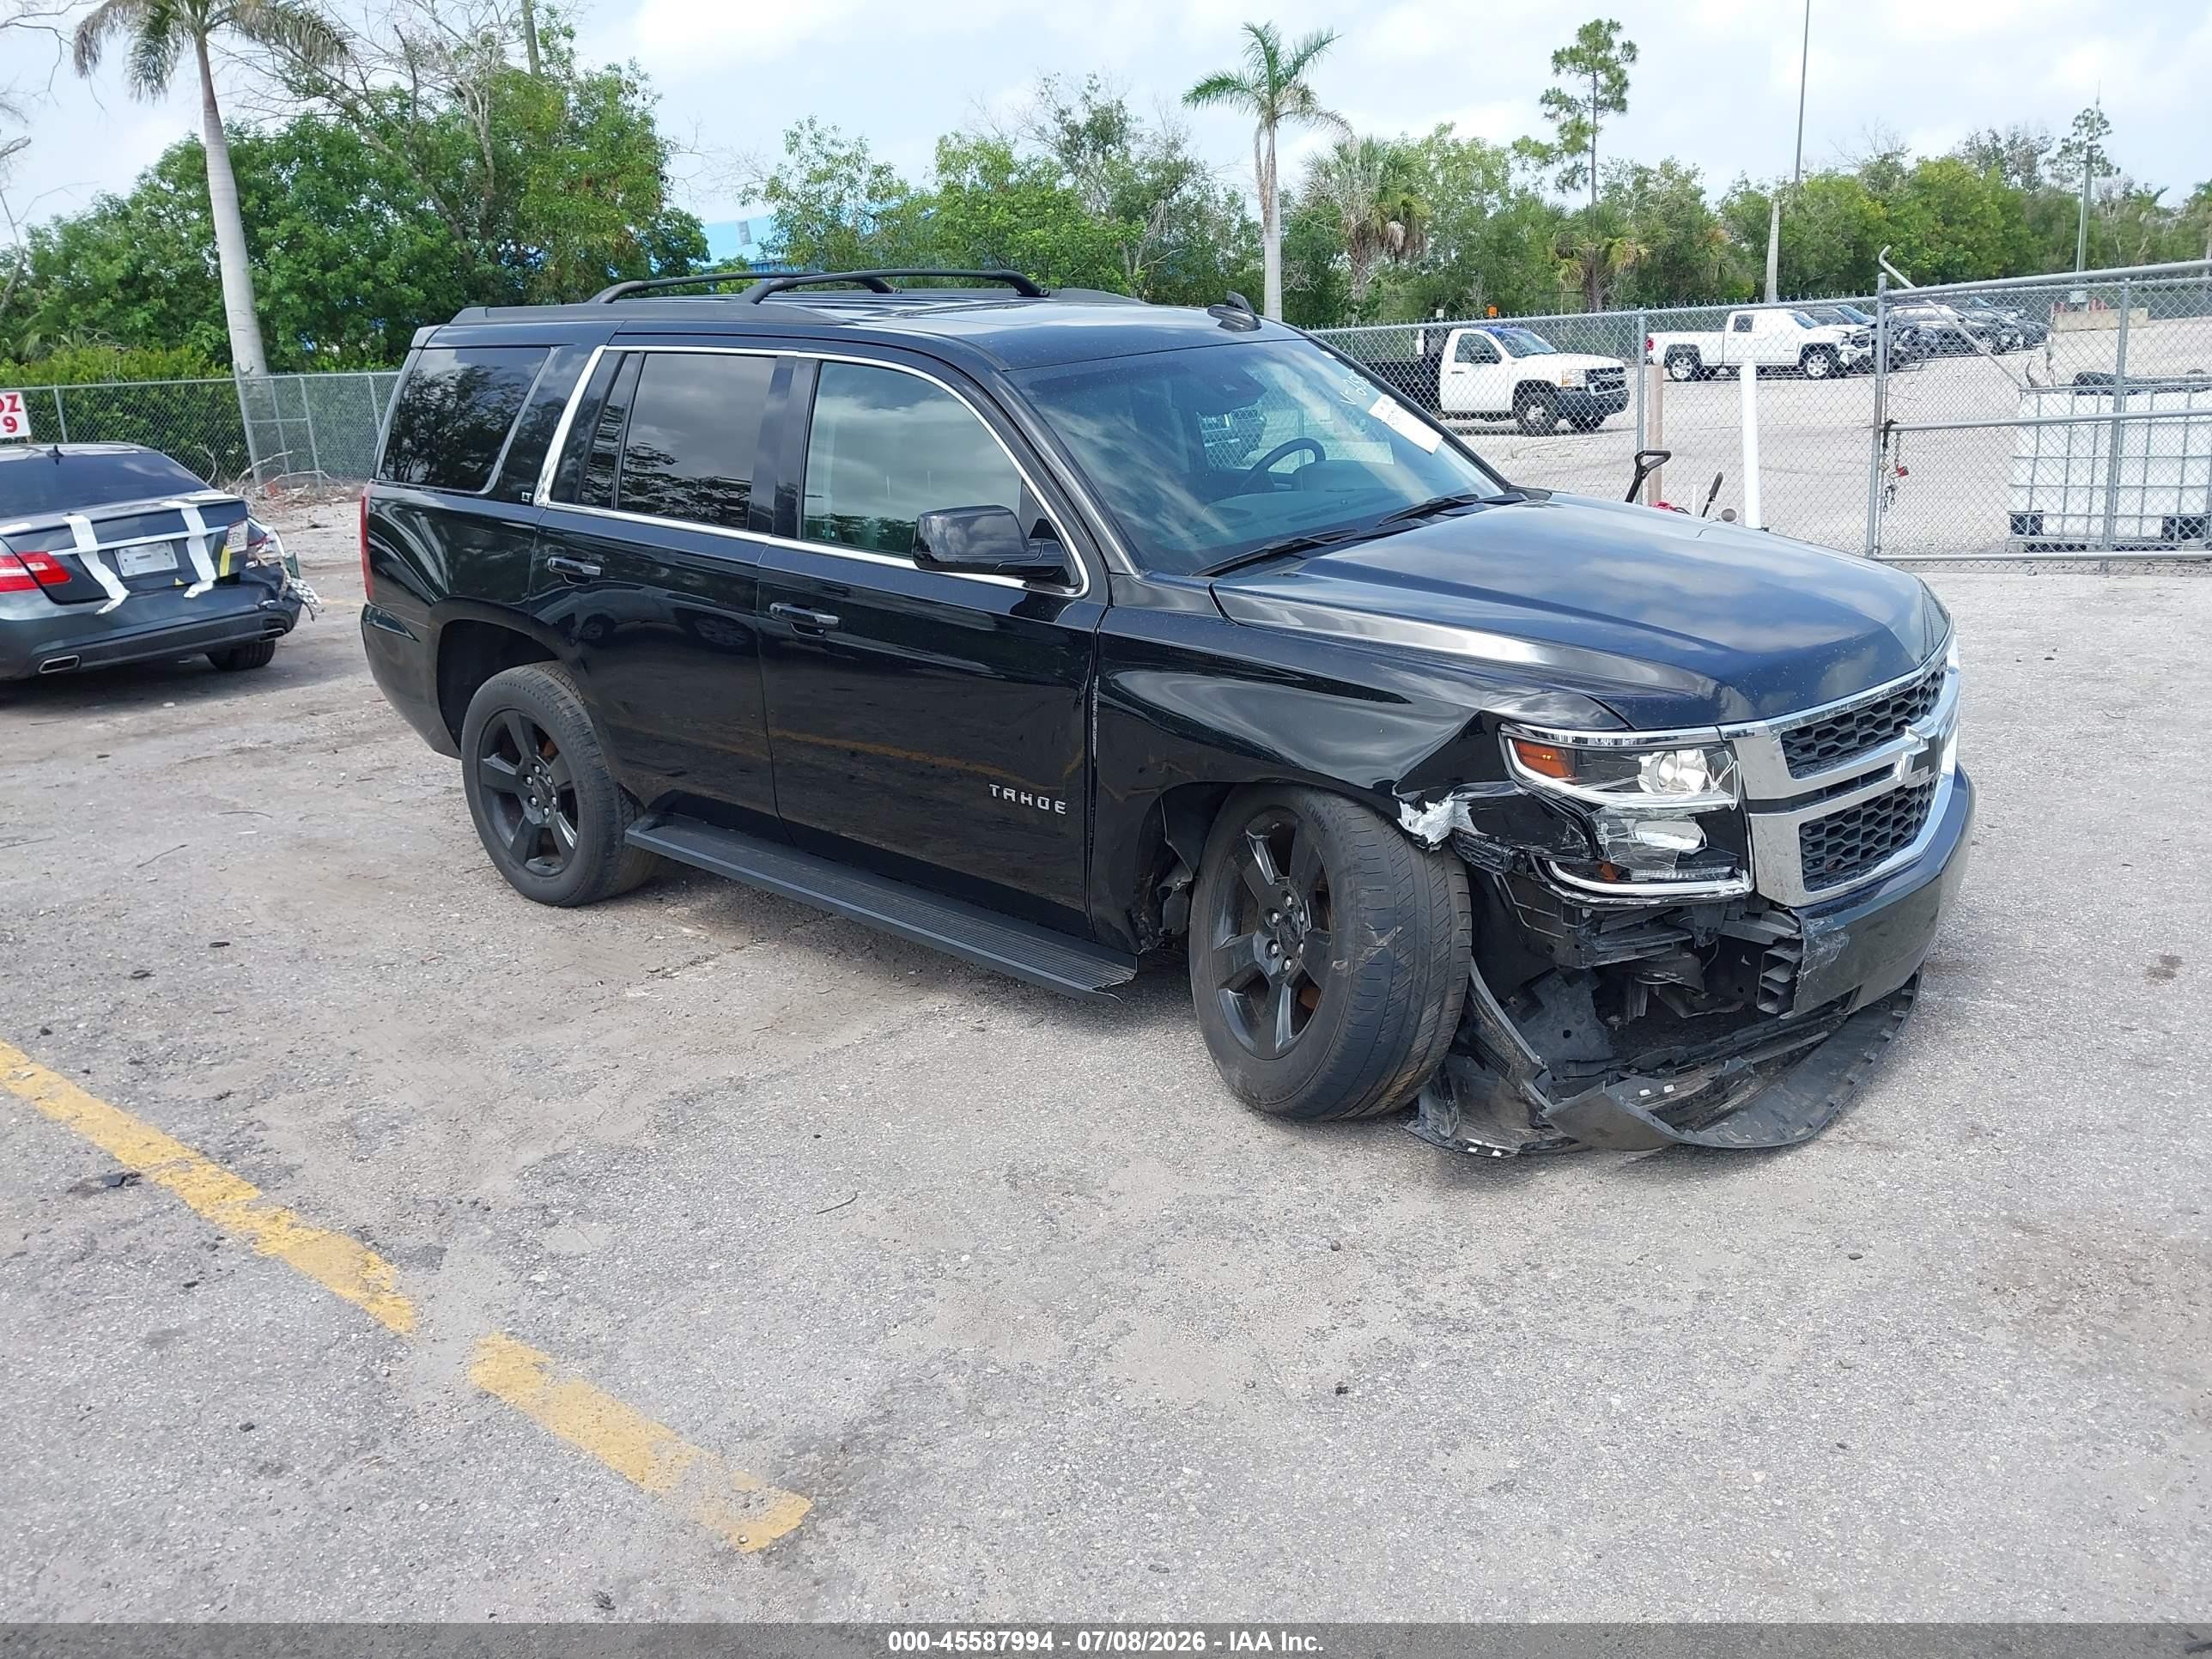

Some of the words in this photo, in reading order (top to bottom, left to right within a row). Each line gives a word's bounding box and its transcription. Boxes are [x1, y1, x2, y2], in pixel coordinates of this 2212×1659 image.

[3, 416, 18, 434] 9
[521, 491, 532, 502] LT
[988, 783, 1066, 815] TAHOE
